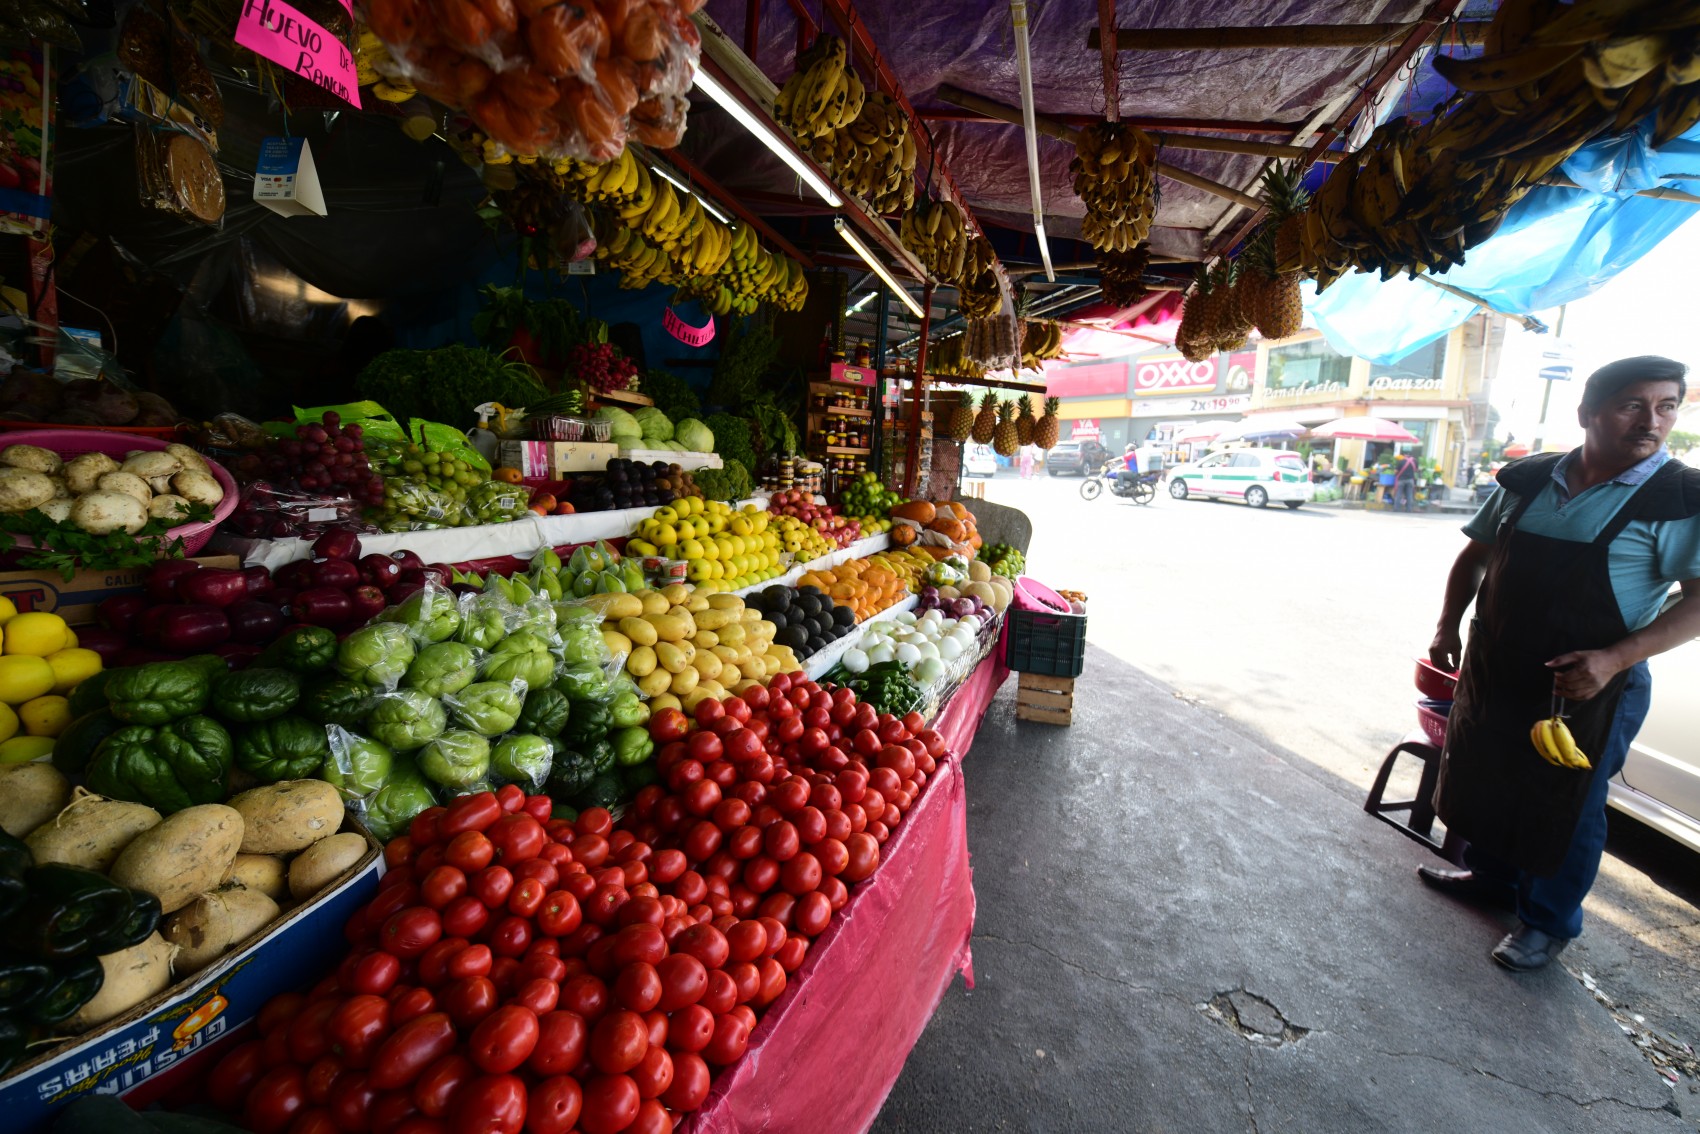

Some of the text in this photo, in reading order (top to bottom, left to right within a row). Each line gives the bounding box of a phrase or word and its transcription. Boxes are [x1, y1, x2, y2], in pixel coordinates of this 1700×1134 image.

[244, 0, 322, 54] HUEVO
[1138, 359, 1214, 387] OXXO
[1078, 419, 1094, 428] YA
[105, 574, 144, 586] CALIF
[37, 1025, 161, 1101] PEARS
[92, 1015, 227, 1097] GOSLIN
